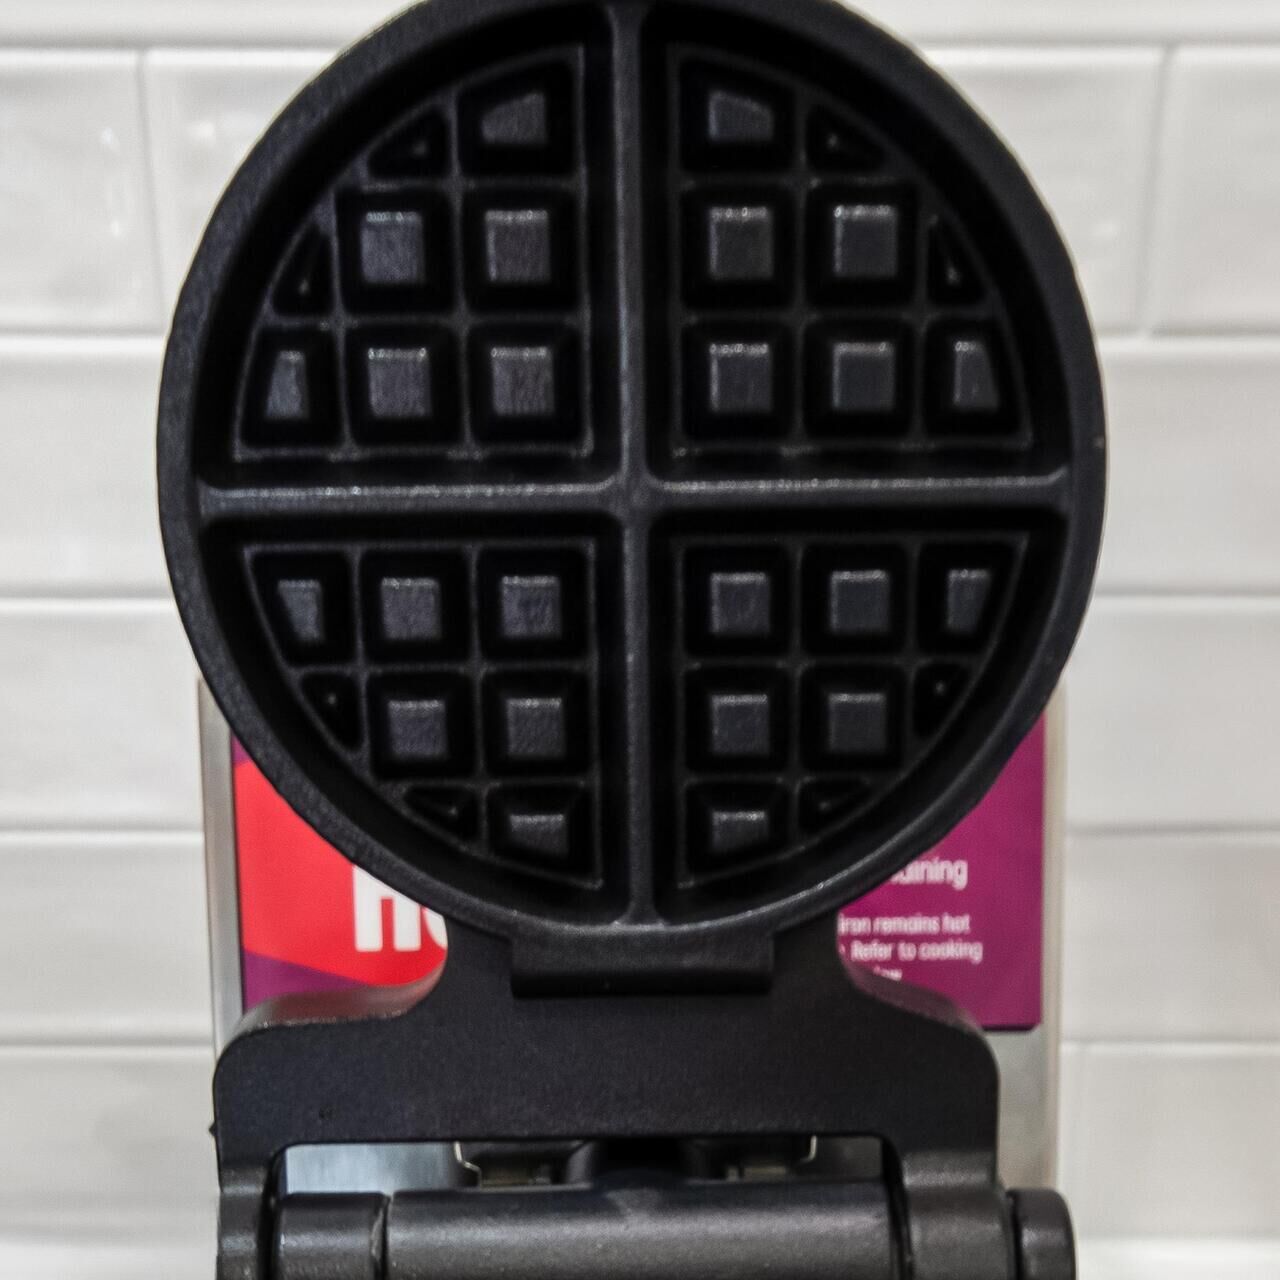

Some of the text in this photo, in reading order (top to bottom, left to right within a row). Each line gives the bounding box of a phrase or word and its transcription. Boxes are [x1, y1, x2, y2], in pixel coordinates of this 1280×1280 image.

[889, 857, 968, 891] aining
[872, 912, 940, 935] remains
[941, 912, 970, 935] hot
[850, 938, 983, 964] Refer to cooking
